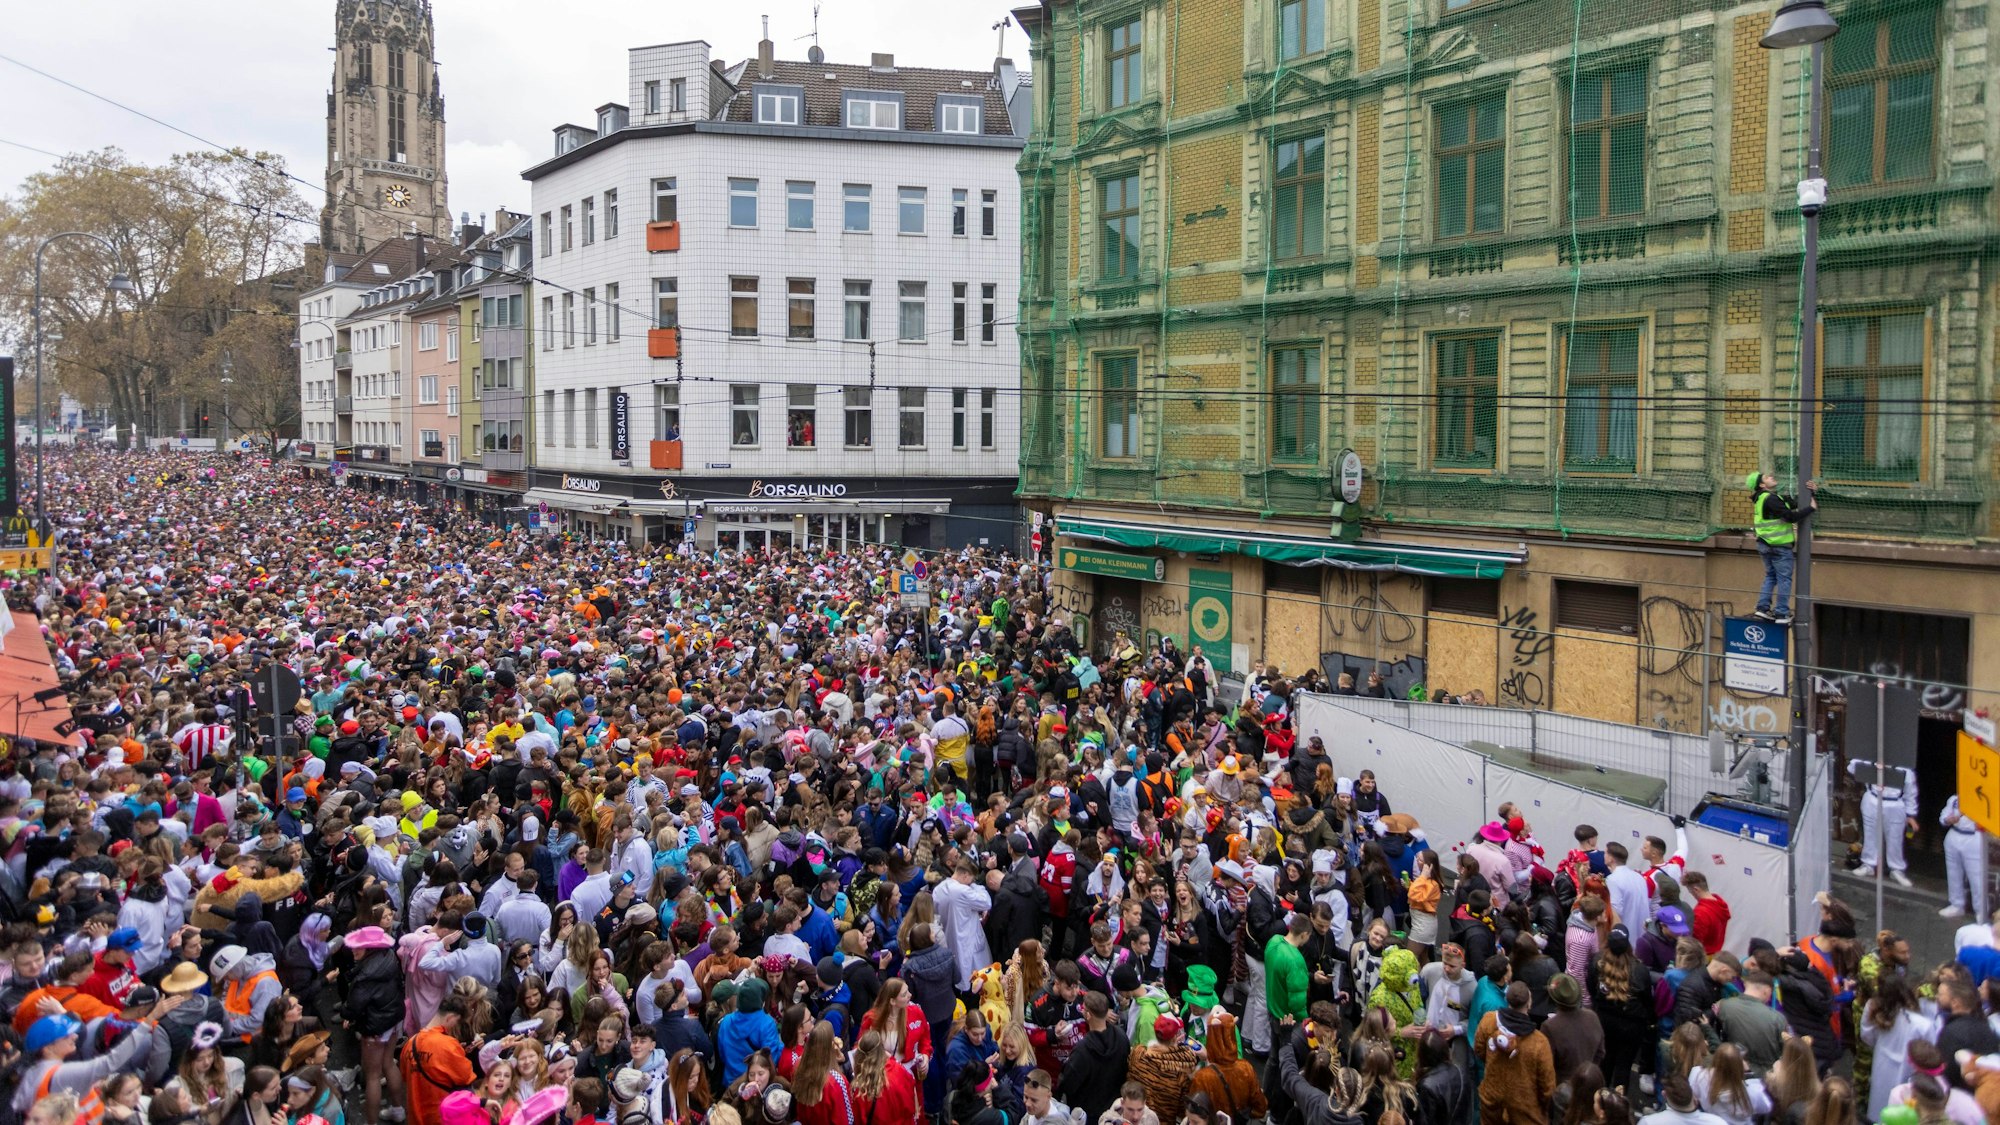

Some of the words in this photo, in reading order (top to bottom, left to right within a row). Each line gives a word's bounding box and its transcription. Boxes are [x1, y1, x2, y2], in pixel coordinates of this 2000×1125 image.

[615, 395, 627, 458] BORSALINO
[562, 473, 600, 492] BORSALINO
[749, 480, 846, 497] BORSALINO
[1092, 557, 1107, 565] OMA
[1108, 559, 1147, 570] KLEINMANN
[1969, 754, 1987, 778] U3
